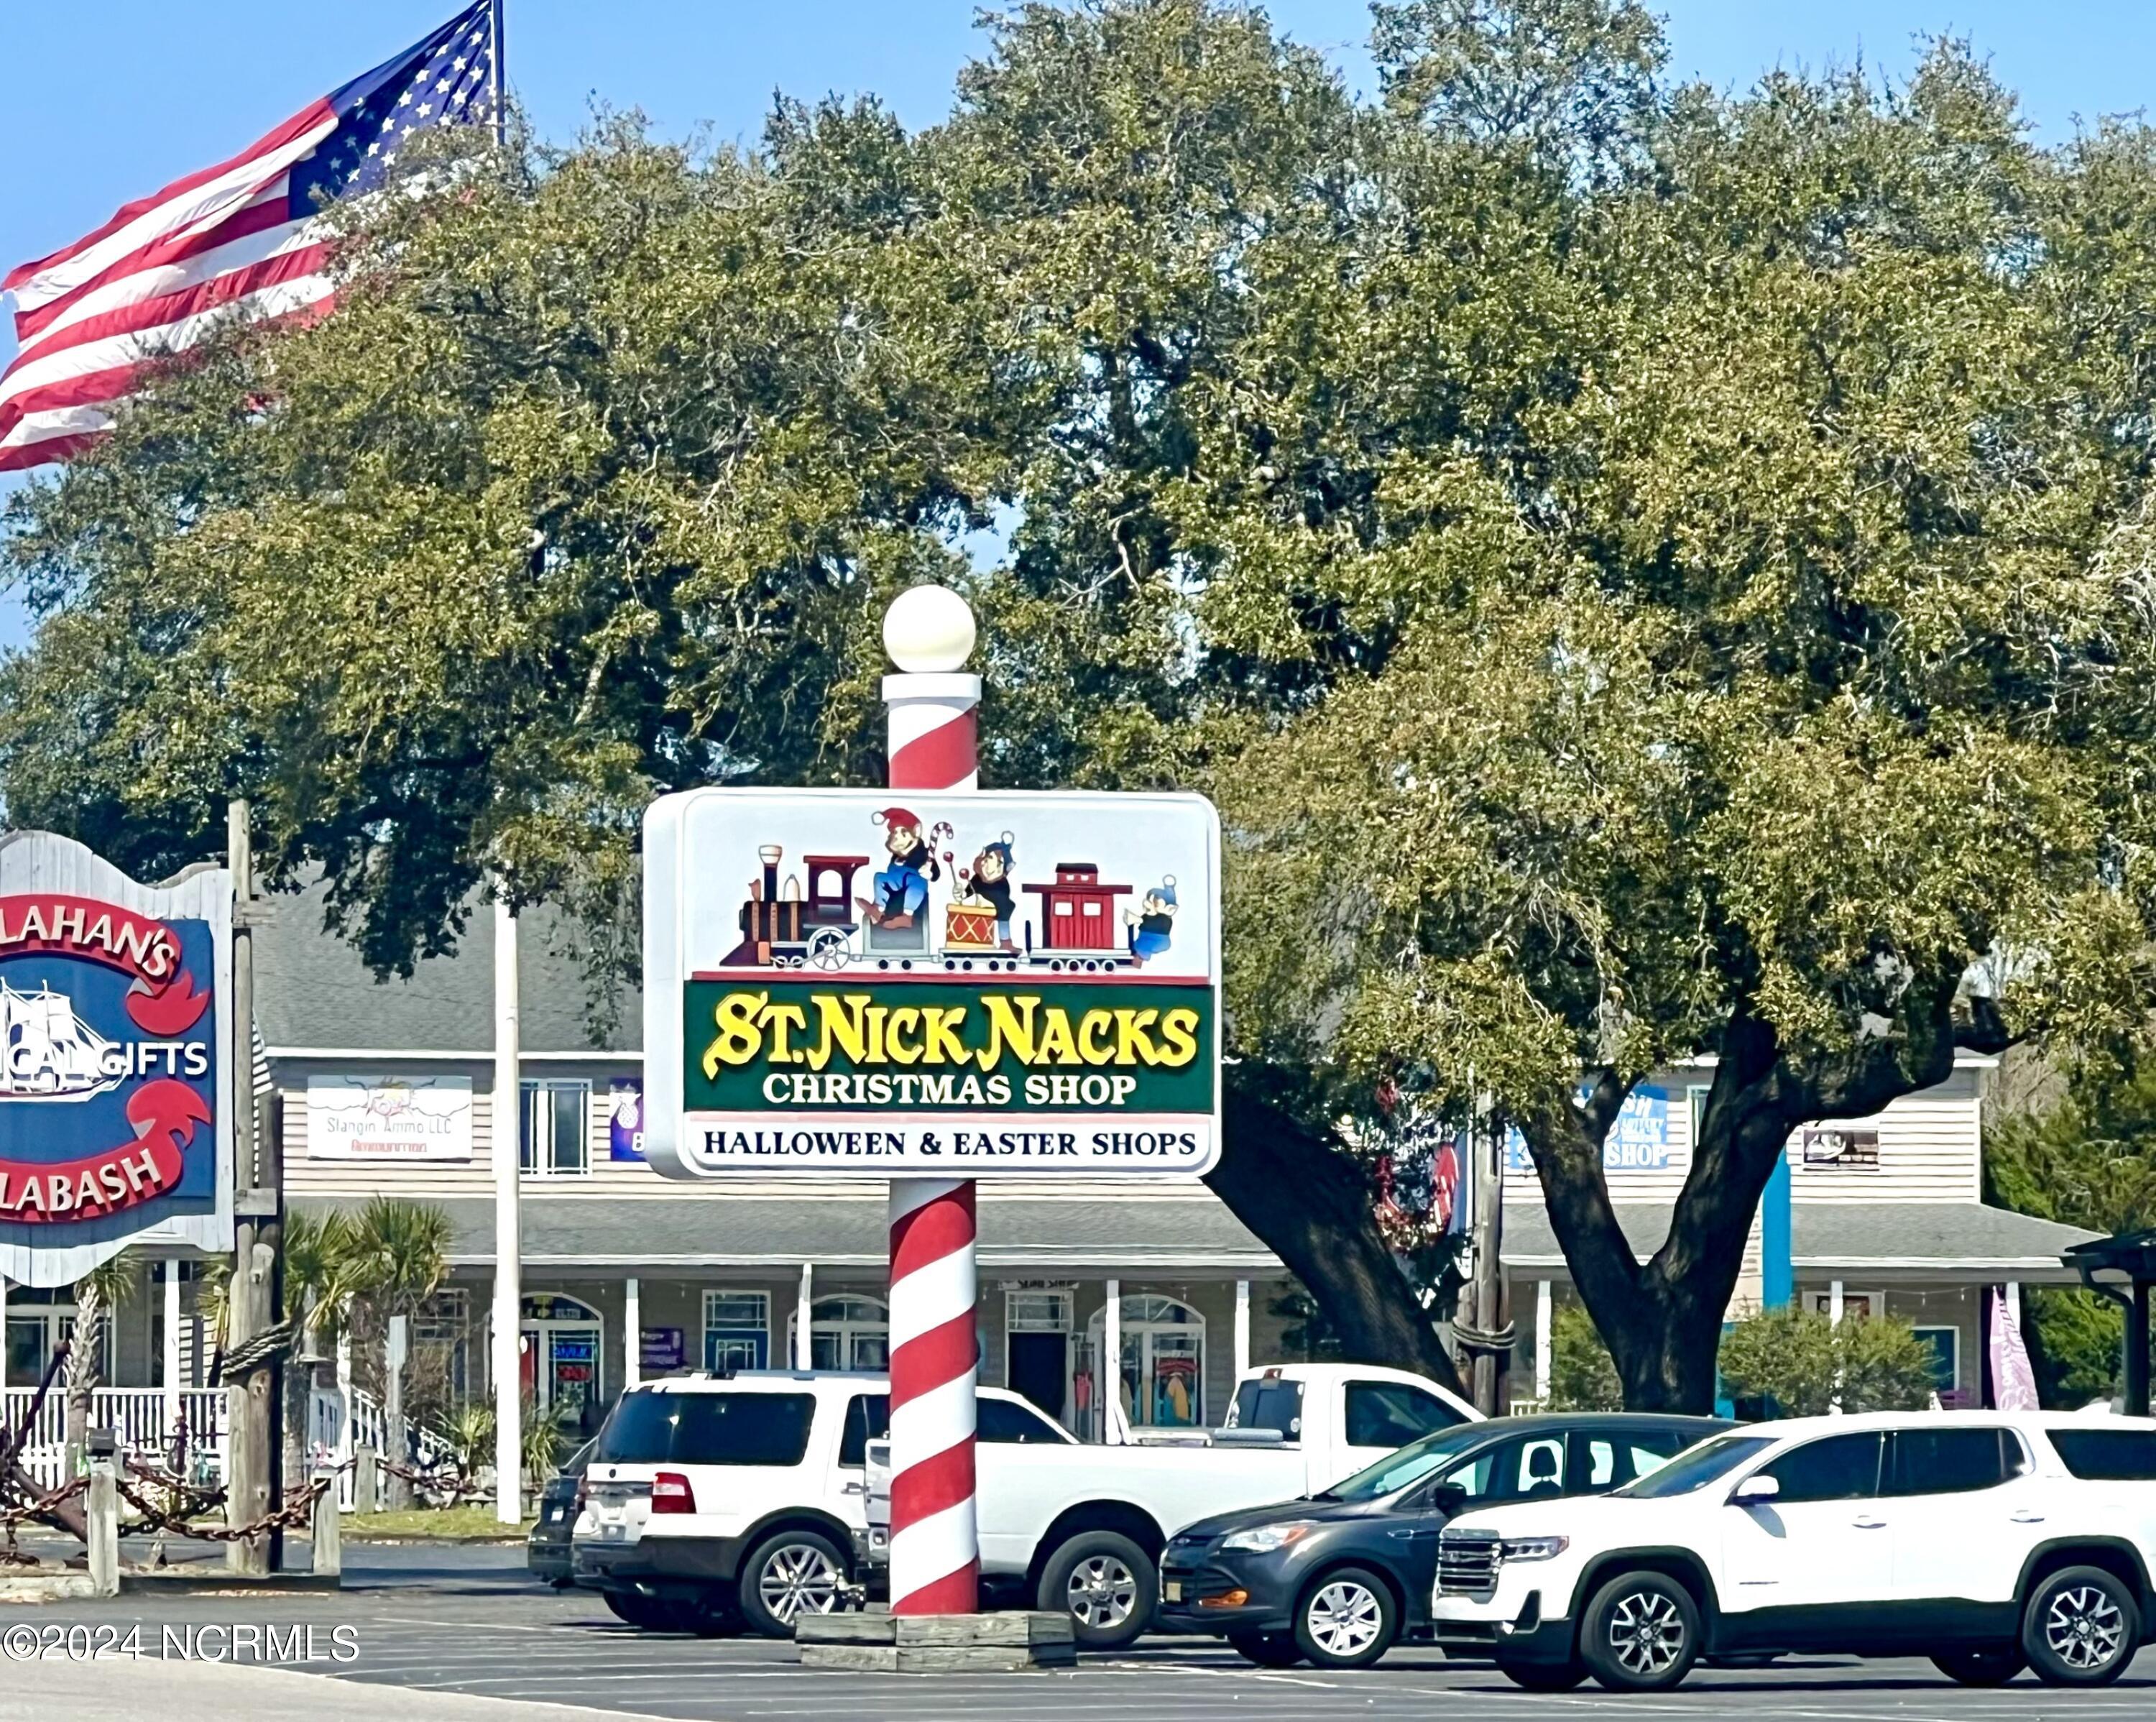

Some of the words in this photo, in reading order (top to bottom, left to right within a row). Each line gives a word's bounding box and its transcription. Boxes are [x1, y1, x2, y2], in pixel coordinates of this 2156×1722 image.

[974, 995, 1199, 1069] NACKS
[98, 1041, 208, 1076] GIFTS
[762, 1072, 1012, 1105] CHRISTMAS
[1025, 1074, 1137, 1106] SHOP
[429, 1118, 452, 1134] LLC
[704, 1131, 906, 1156] HALLOWEEN
[920, 1132, 942, 1156] &
[952, 1132, 1079, 1156] EASTER
[1092, 1132, 1197, 1156] SHOPS
[1606, 1143, 1669, 1166] SHOP
[0, 1148, 162, 1212] LABASH
